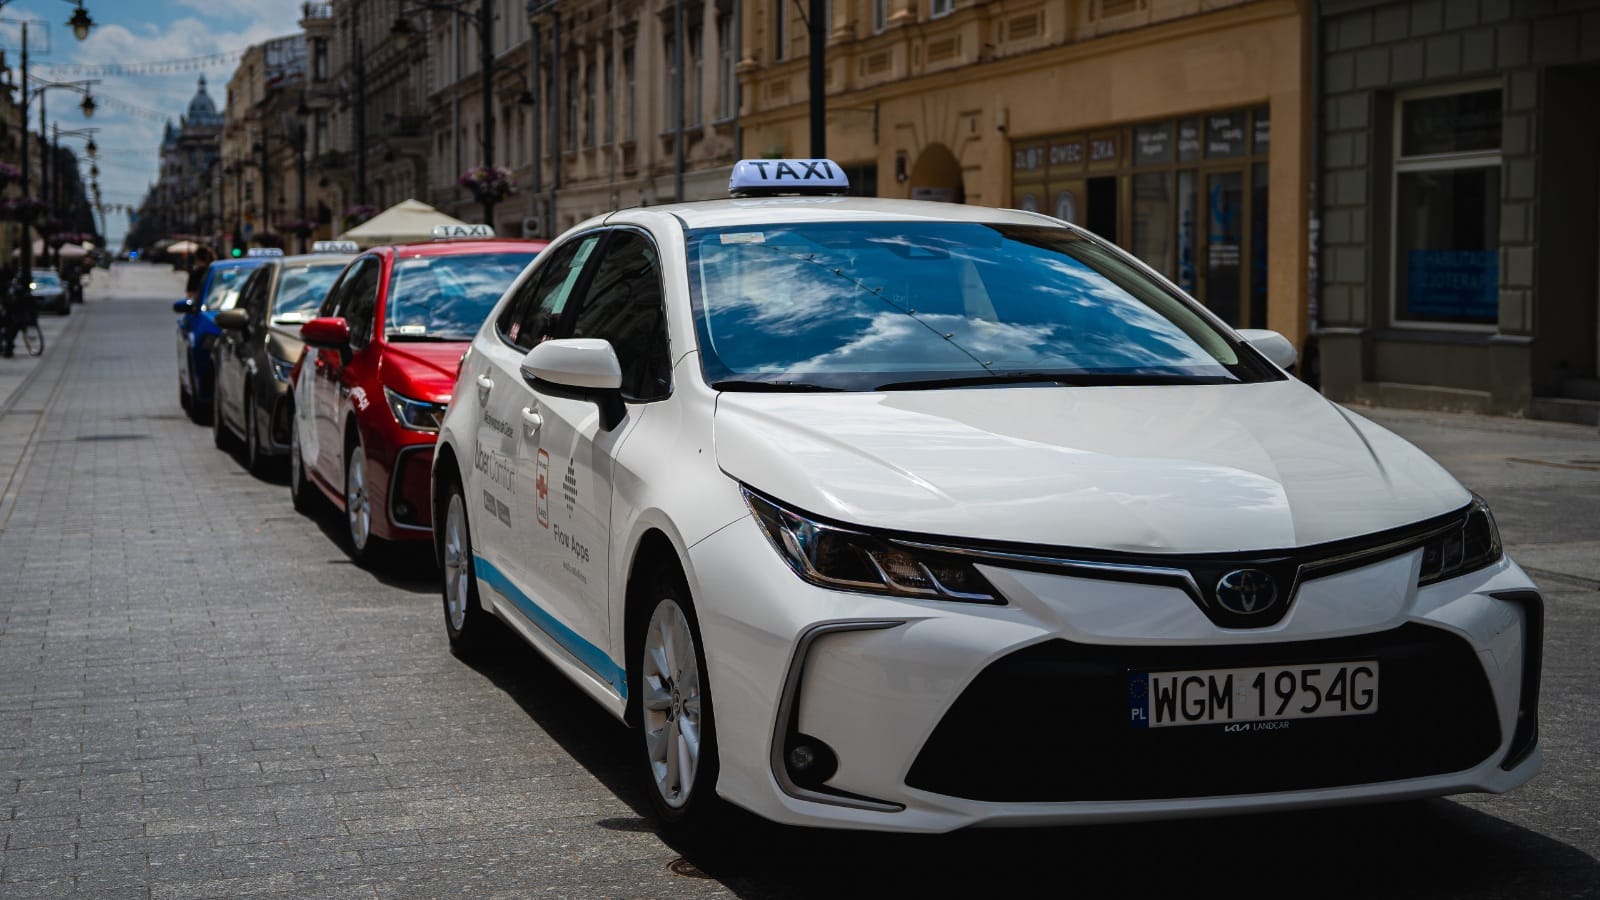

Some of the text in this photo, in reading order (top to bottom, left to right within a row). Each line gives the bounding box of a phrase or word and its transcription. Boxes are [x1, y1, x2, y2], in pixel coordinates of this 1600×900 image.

[748, 161, 834, 180] TAXI
[440, 225, 488, 236] TAXI
[320, 241, 355, 252] TAXI
[553, 523, 590, 563] Flow Apps
[1153, 667, 1374, 723] WGM 1954G
[1131, 708, 1147, 720] PL
[1253, 721, 1290, 731] LANDCAR
